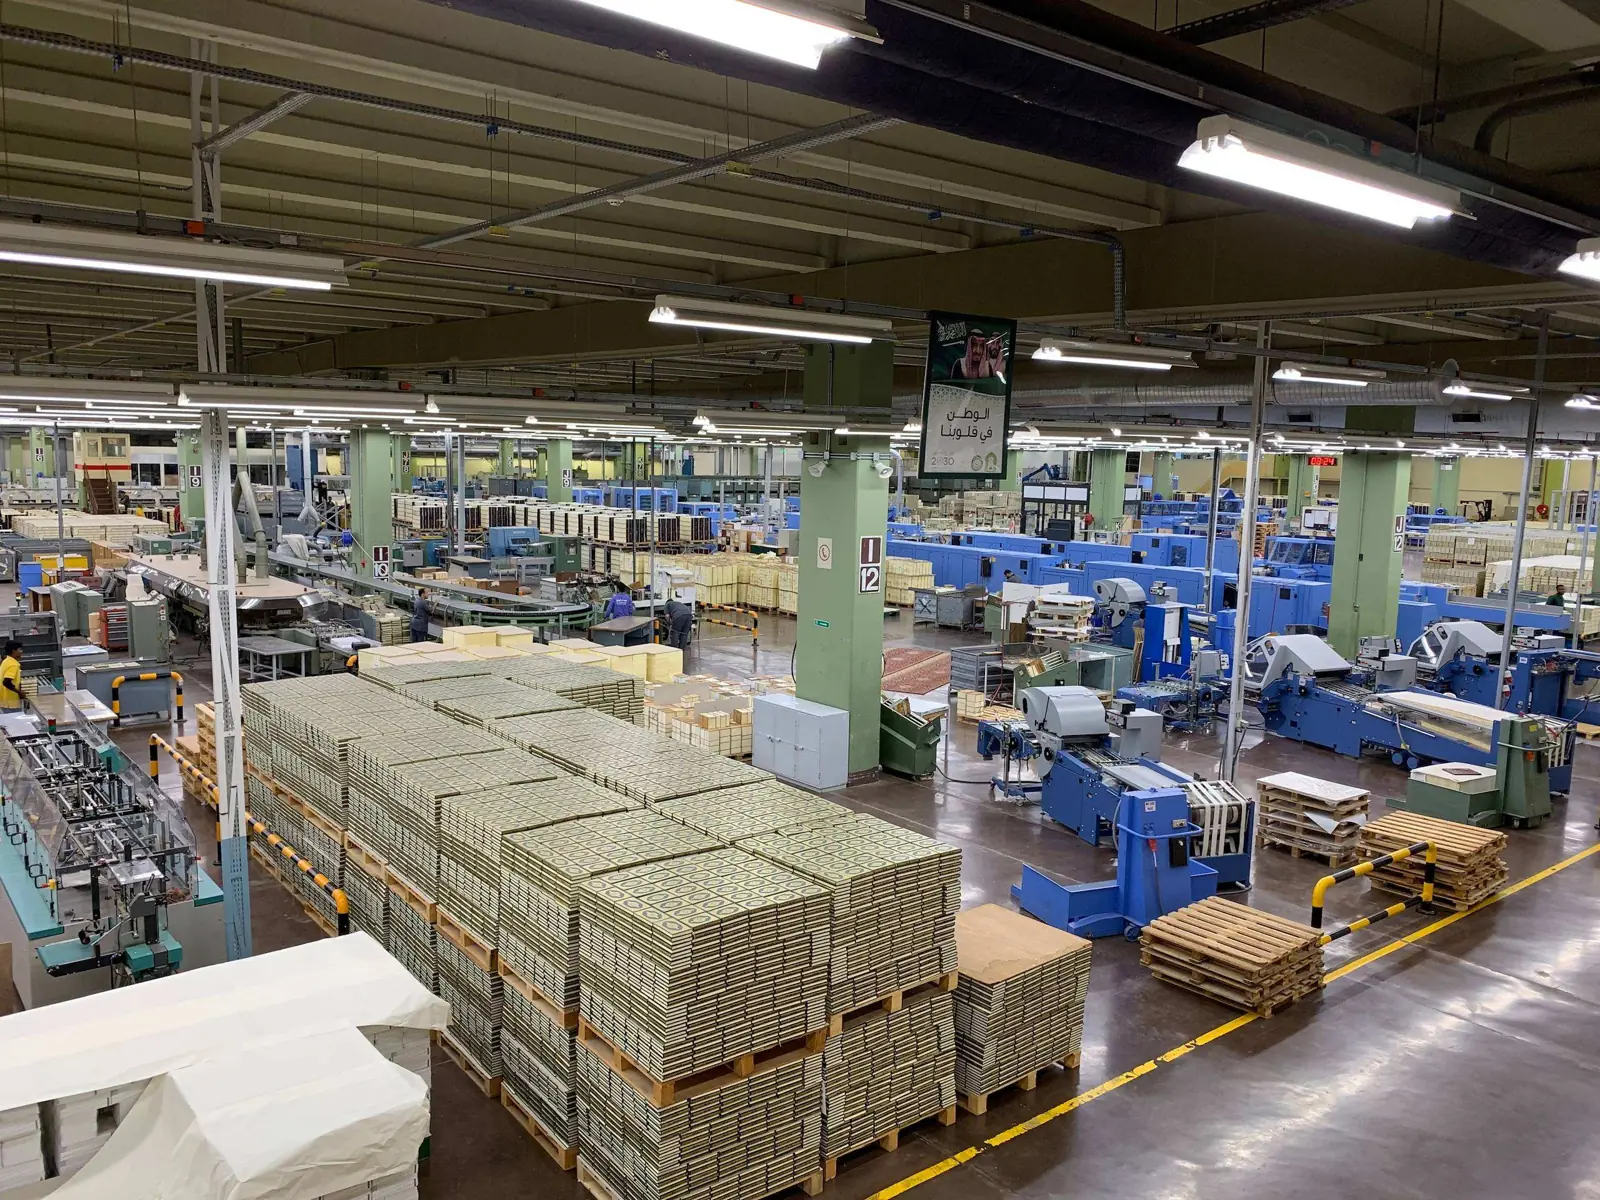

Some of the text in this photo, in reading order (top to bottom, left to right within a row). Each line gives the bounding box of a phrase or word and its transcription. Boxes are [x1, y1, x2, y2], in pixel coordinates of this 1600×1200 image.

[946, 407, 990, 421] الوطن
[940, 424, 993, 444] في قلوبنا
[564, 470, 570, 478] J
[191, 477, 200, 487] 9
[563, 479, 570, 487] 9
[1396, 516, 1403, 532] J
[1395, 535, 1403, 551] 12
[374, 563, 388, 577] 10
[861, 567, 879, 592] 12
